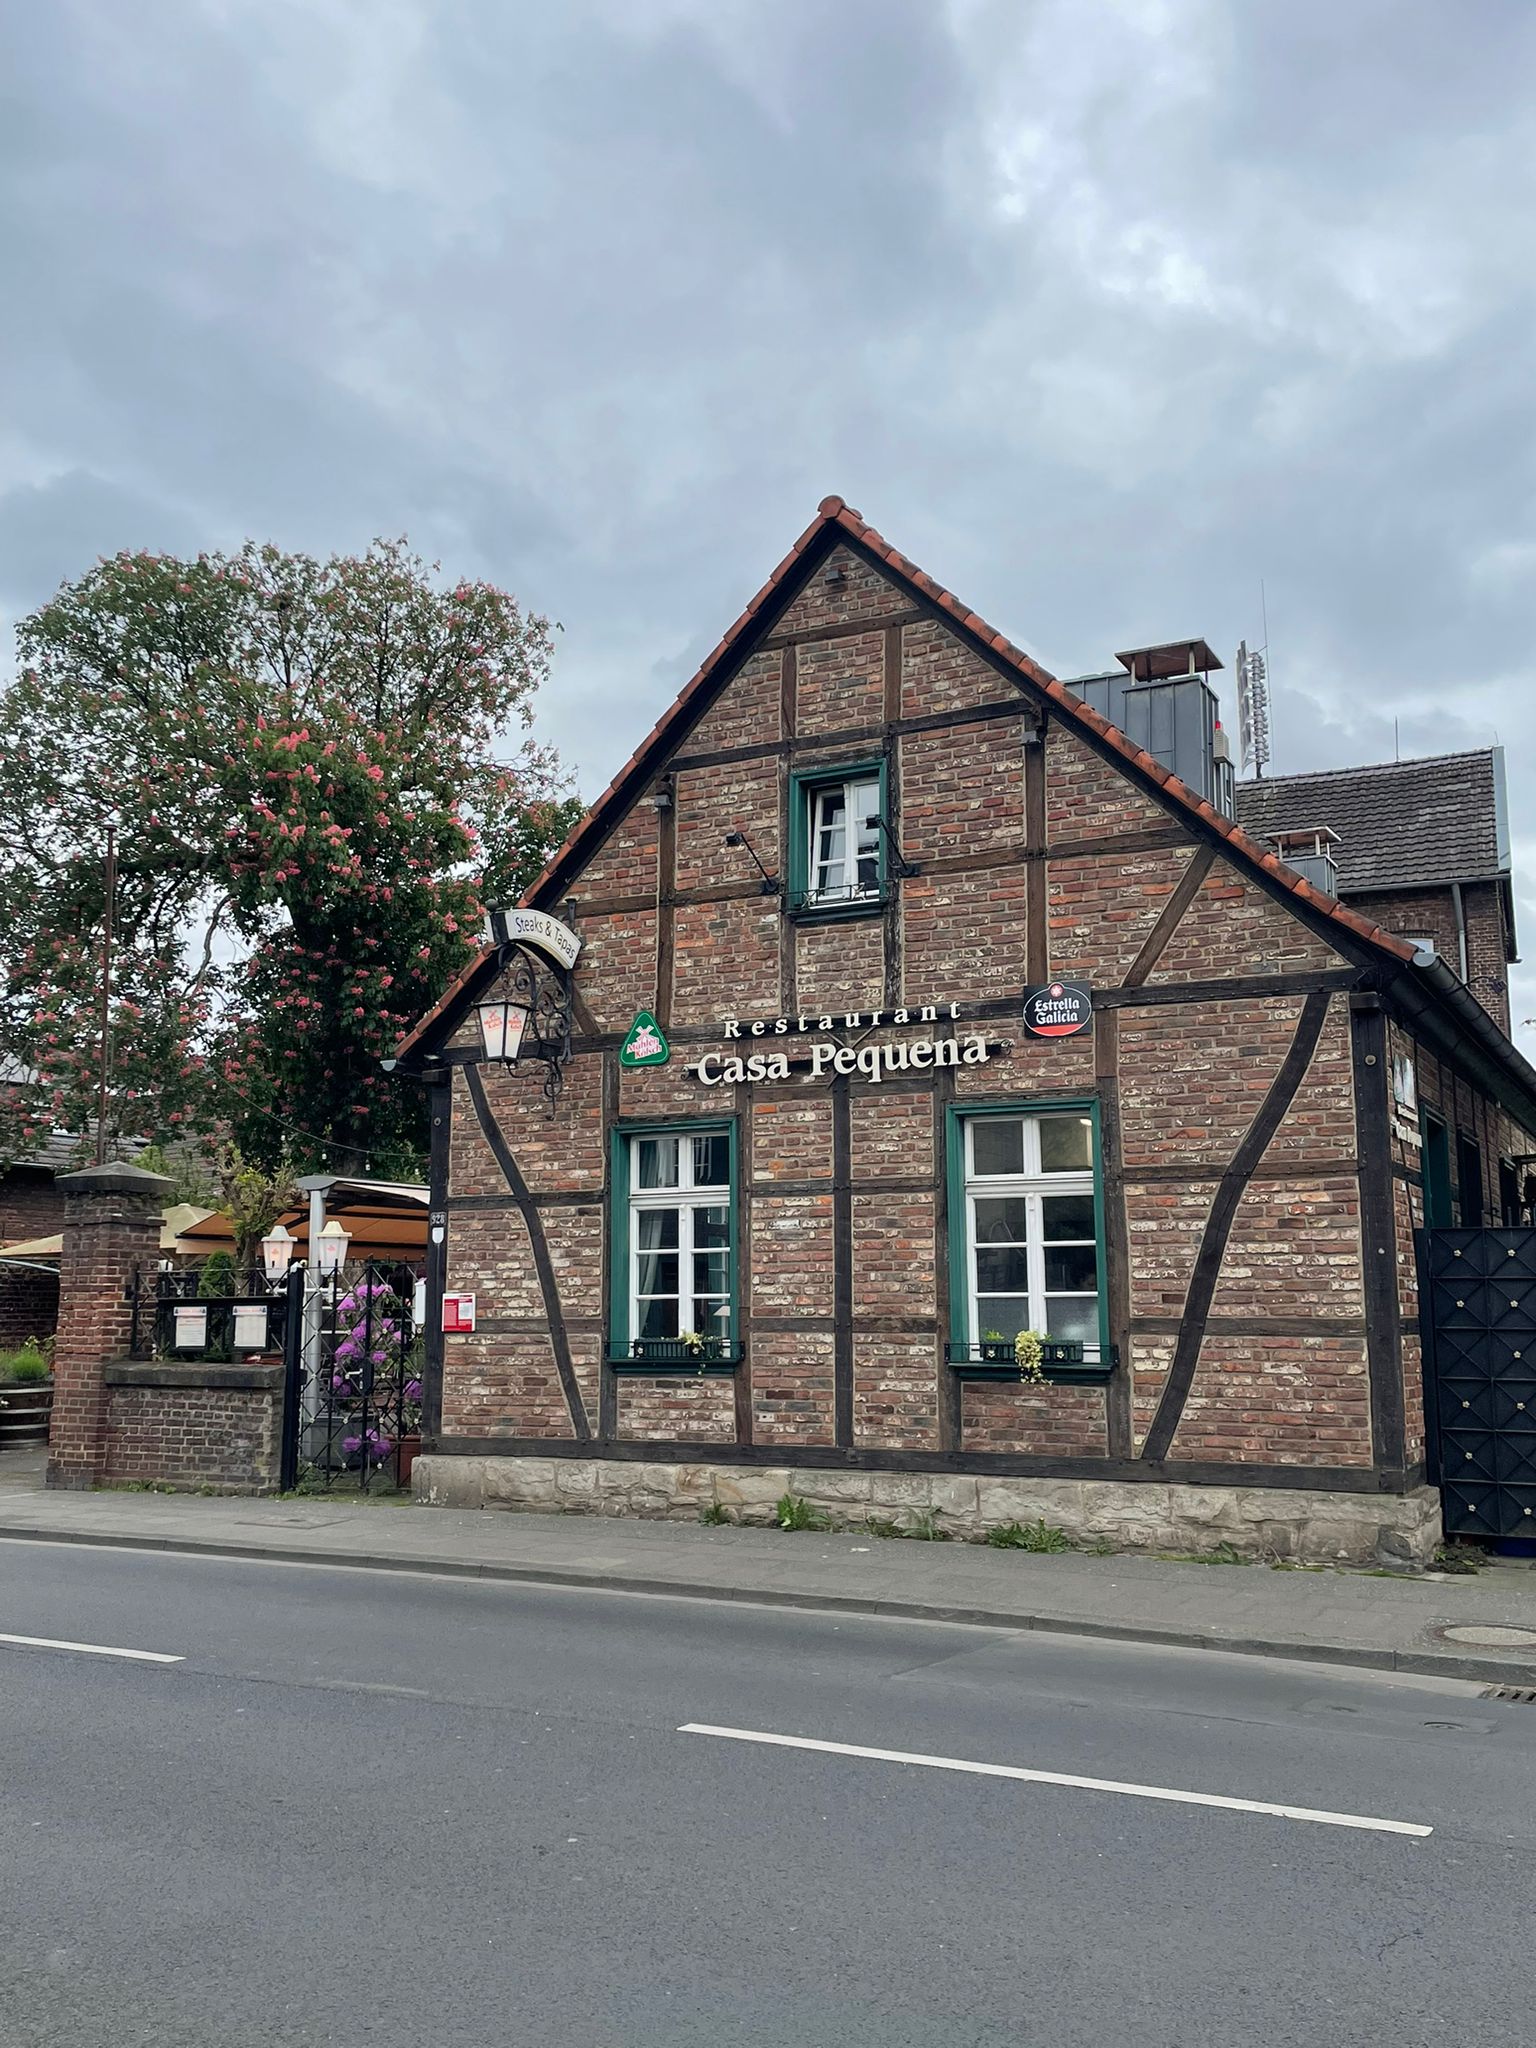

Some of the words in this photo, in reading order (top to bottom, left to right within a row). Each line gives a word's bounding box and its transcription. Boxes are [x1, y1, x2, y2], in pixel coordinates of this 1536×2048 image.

[515, 916, 543, 934] Steaks
[544, 920, 552, 938] &
[554, 926, 576, 959] Tapas
[723, 1000, 961, 1039] Restaurant
[1033, 997, 1080, 1013] Estrella
[1035, 1010, 1079, 1025] Galicia
[697, 1051, 792, 1086] Casa
[809, 1035, 991, 1084] Pequena
